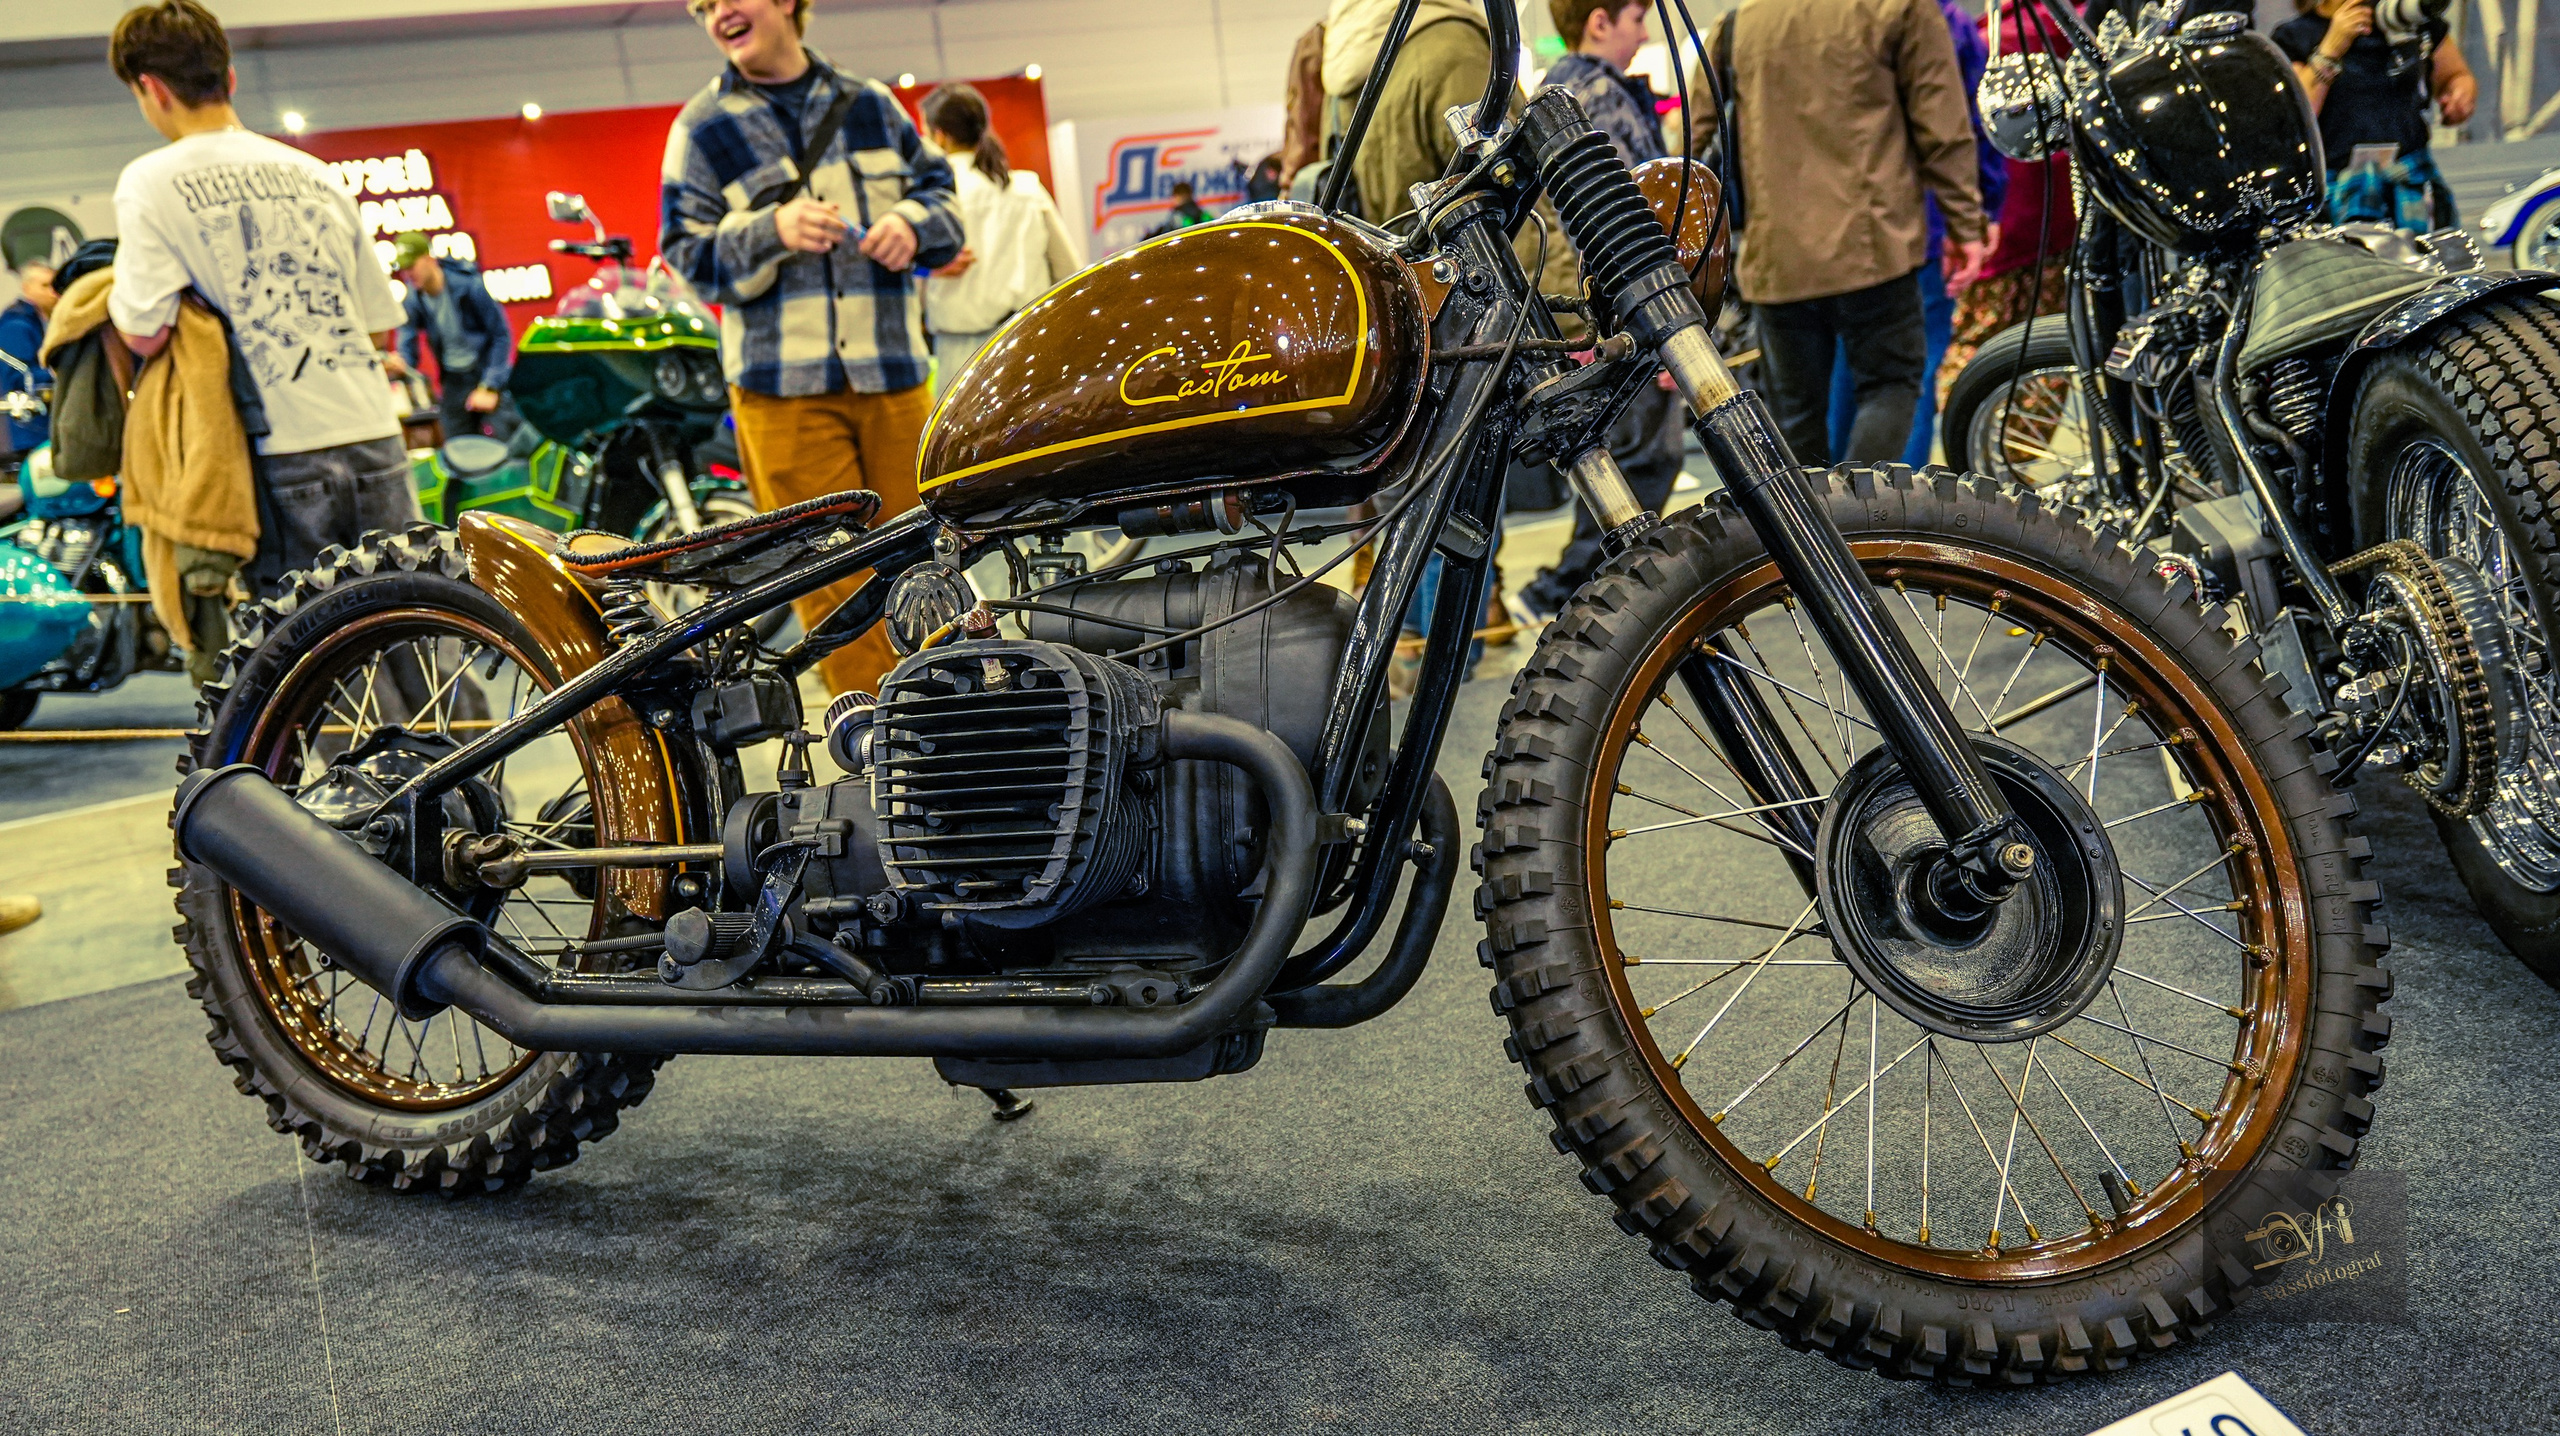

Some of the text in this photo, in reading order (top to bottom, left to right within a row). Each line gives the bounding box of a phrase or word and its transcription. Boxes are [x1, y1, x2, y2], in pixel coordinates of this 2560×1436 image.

[2321, 856, 2334, 870] IN
[2324, 874, 2347, 932] RUSSIA
[436, 1058, 550, 1138] STARCROSS
